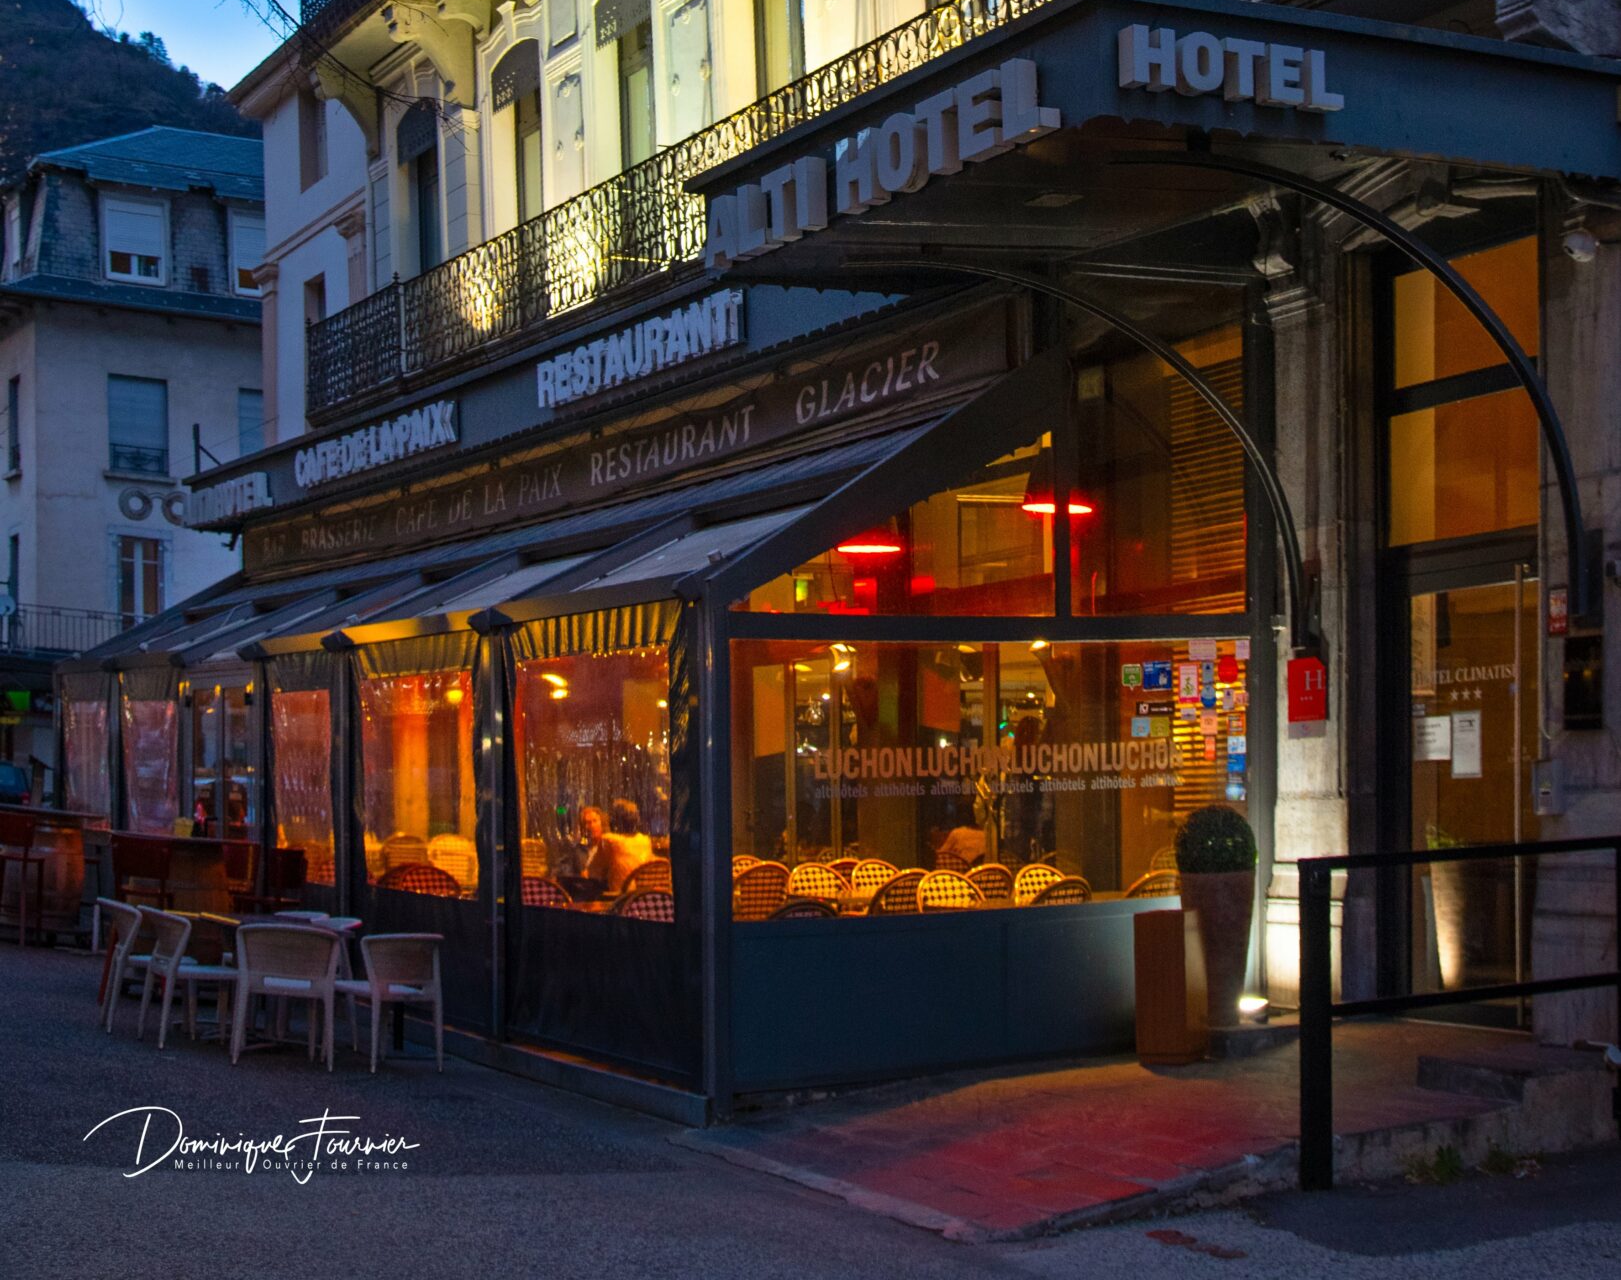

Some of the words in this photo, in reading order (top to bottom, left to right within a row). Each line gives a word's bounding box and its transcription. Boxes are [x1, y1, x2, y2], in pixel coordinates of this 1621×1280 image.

[1118, 23, 1345, 112] HOTEL
[704, 156, 828, 268] ALTI
[835, 57, 1061, 214] HOTEL
[537, 288, 743, 408] RESTAURANT
[301, 515, 376, 554] BRASSERIE
[447, 488, 473, 525] DE
[484, 478, 507, 515] LA
[519, 463, 562, 504] PAIX
[590, 404, 756, 487] RESTAURANT
[795, 340, 940, 424] GLACIER
[1304, 669, 1323, 692] H
[1455, 663, 1519, 683] CLIMATIS
[874, 779, 925, 798] altihôtels
[1039, 775, 1086, 793] altihôtels
[1091, 773, 1136, 791] altihôtels
